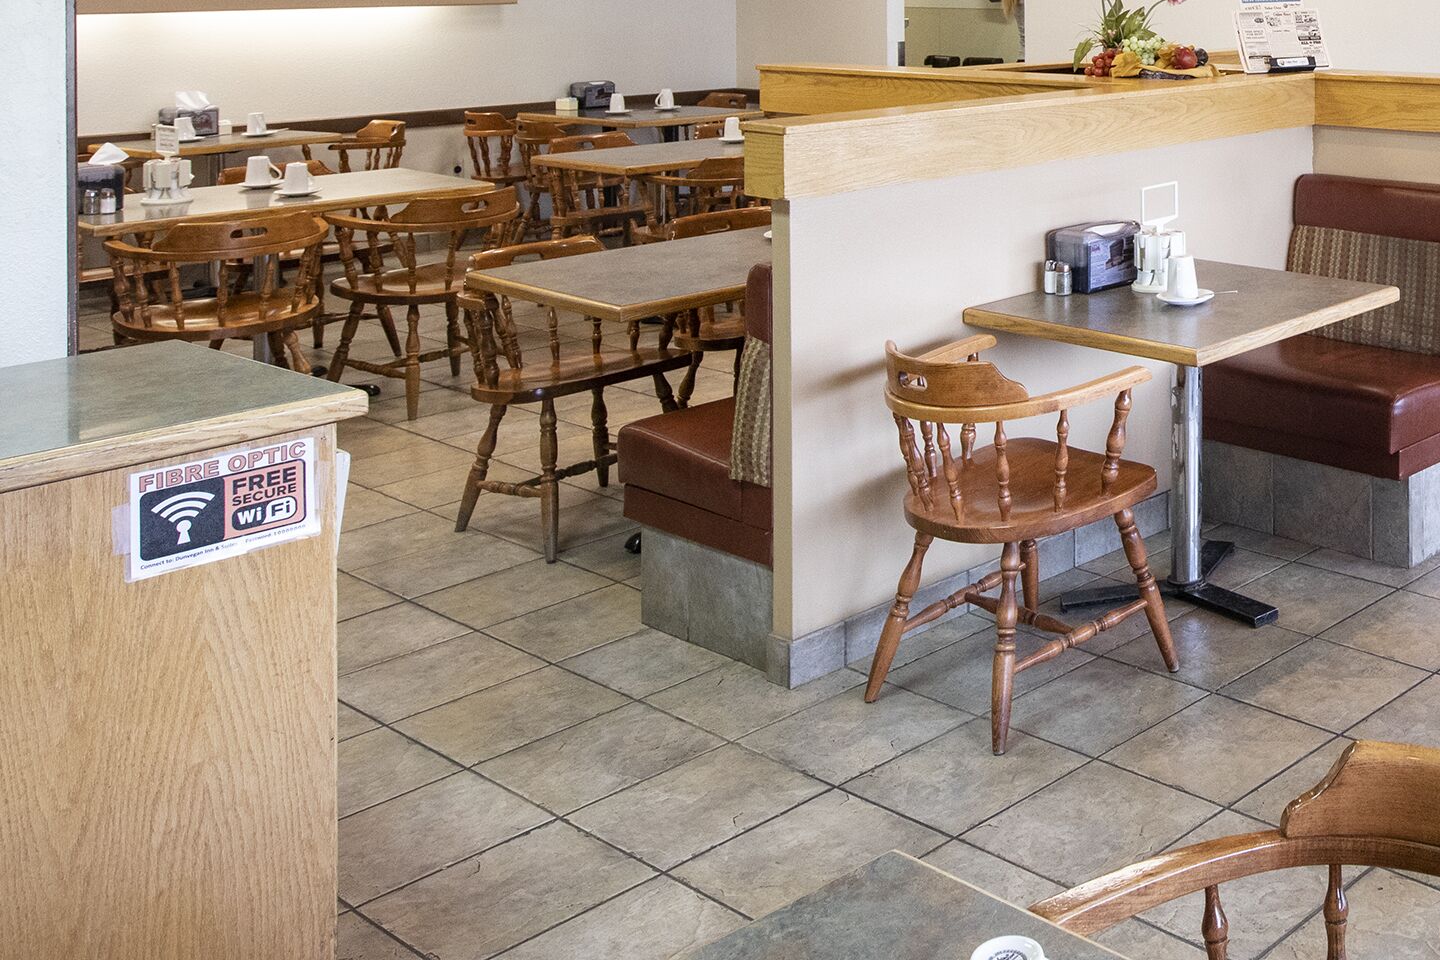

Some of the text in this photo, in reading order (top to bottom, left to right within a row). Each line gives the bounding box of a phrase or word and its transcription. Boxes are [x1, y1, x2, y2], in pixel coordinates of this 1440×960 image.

[138, 441, 306, 493] FIBRE OPTIC
[232, 466, 297, 495] FREE
[232, 484, 297, 507] SECURE
[140, 560, 165, 570] Connect
[175, 550, 203, 562] Dunvegan
